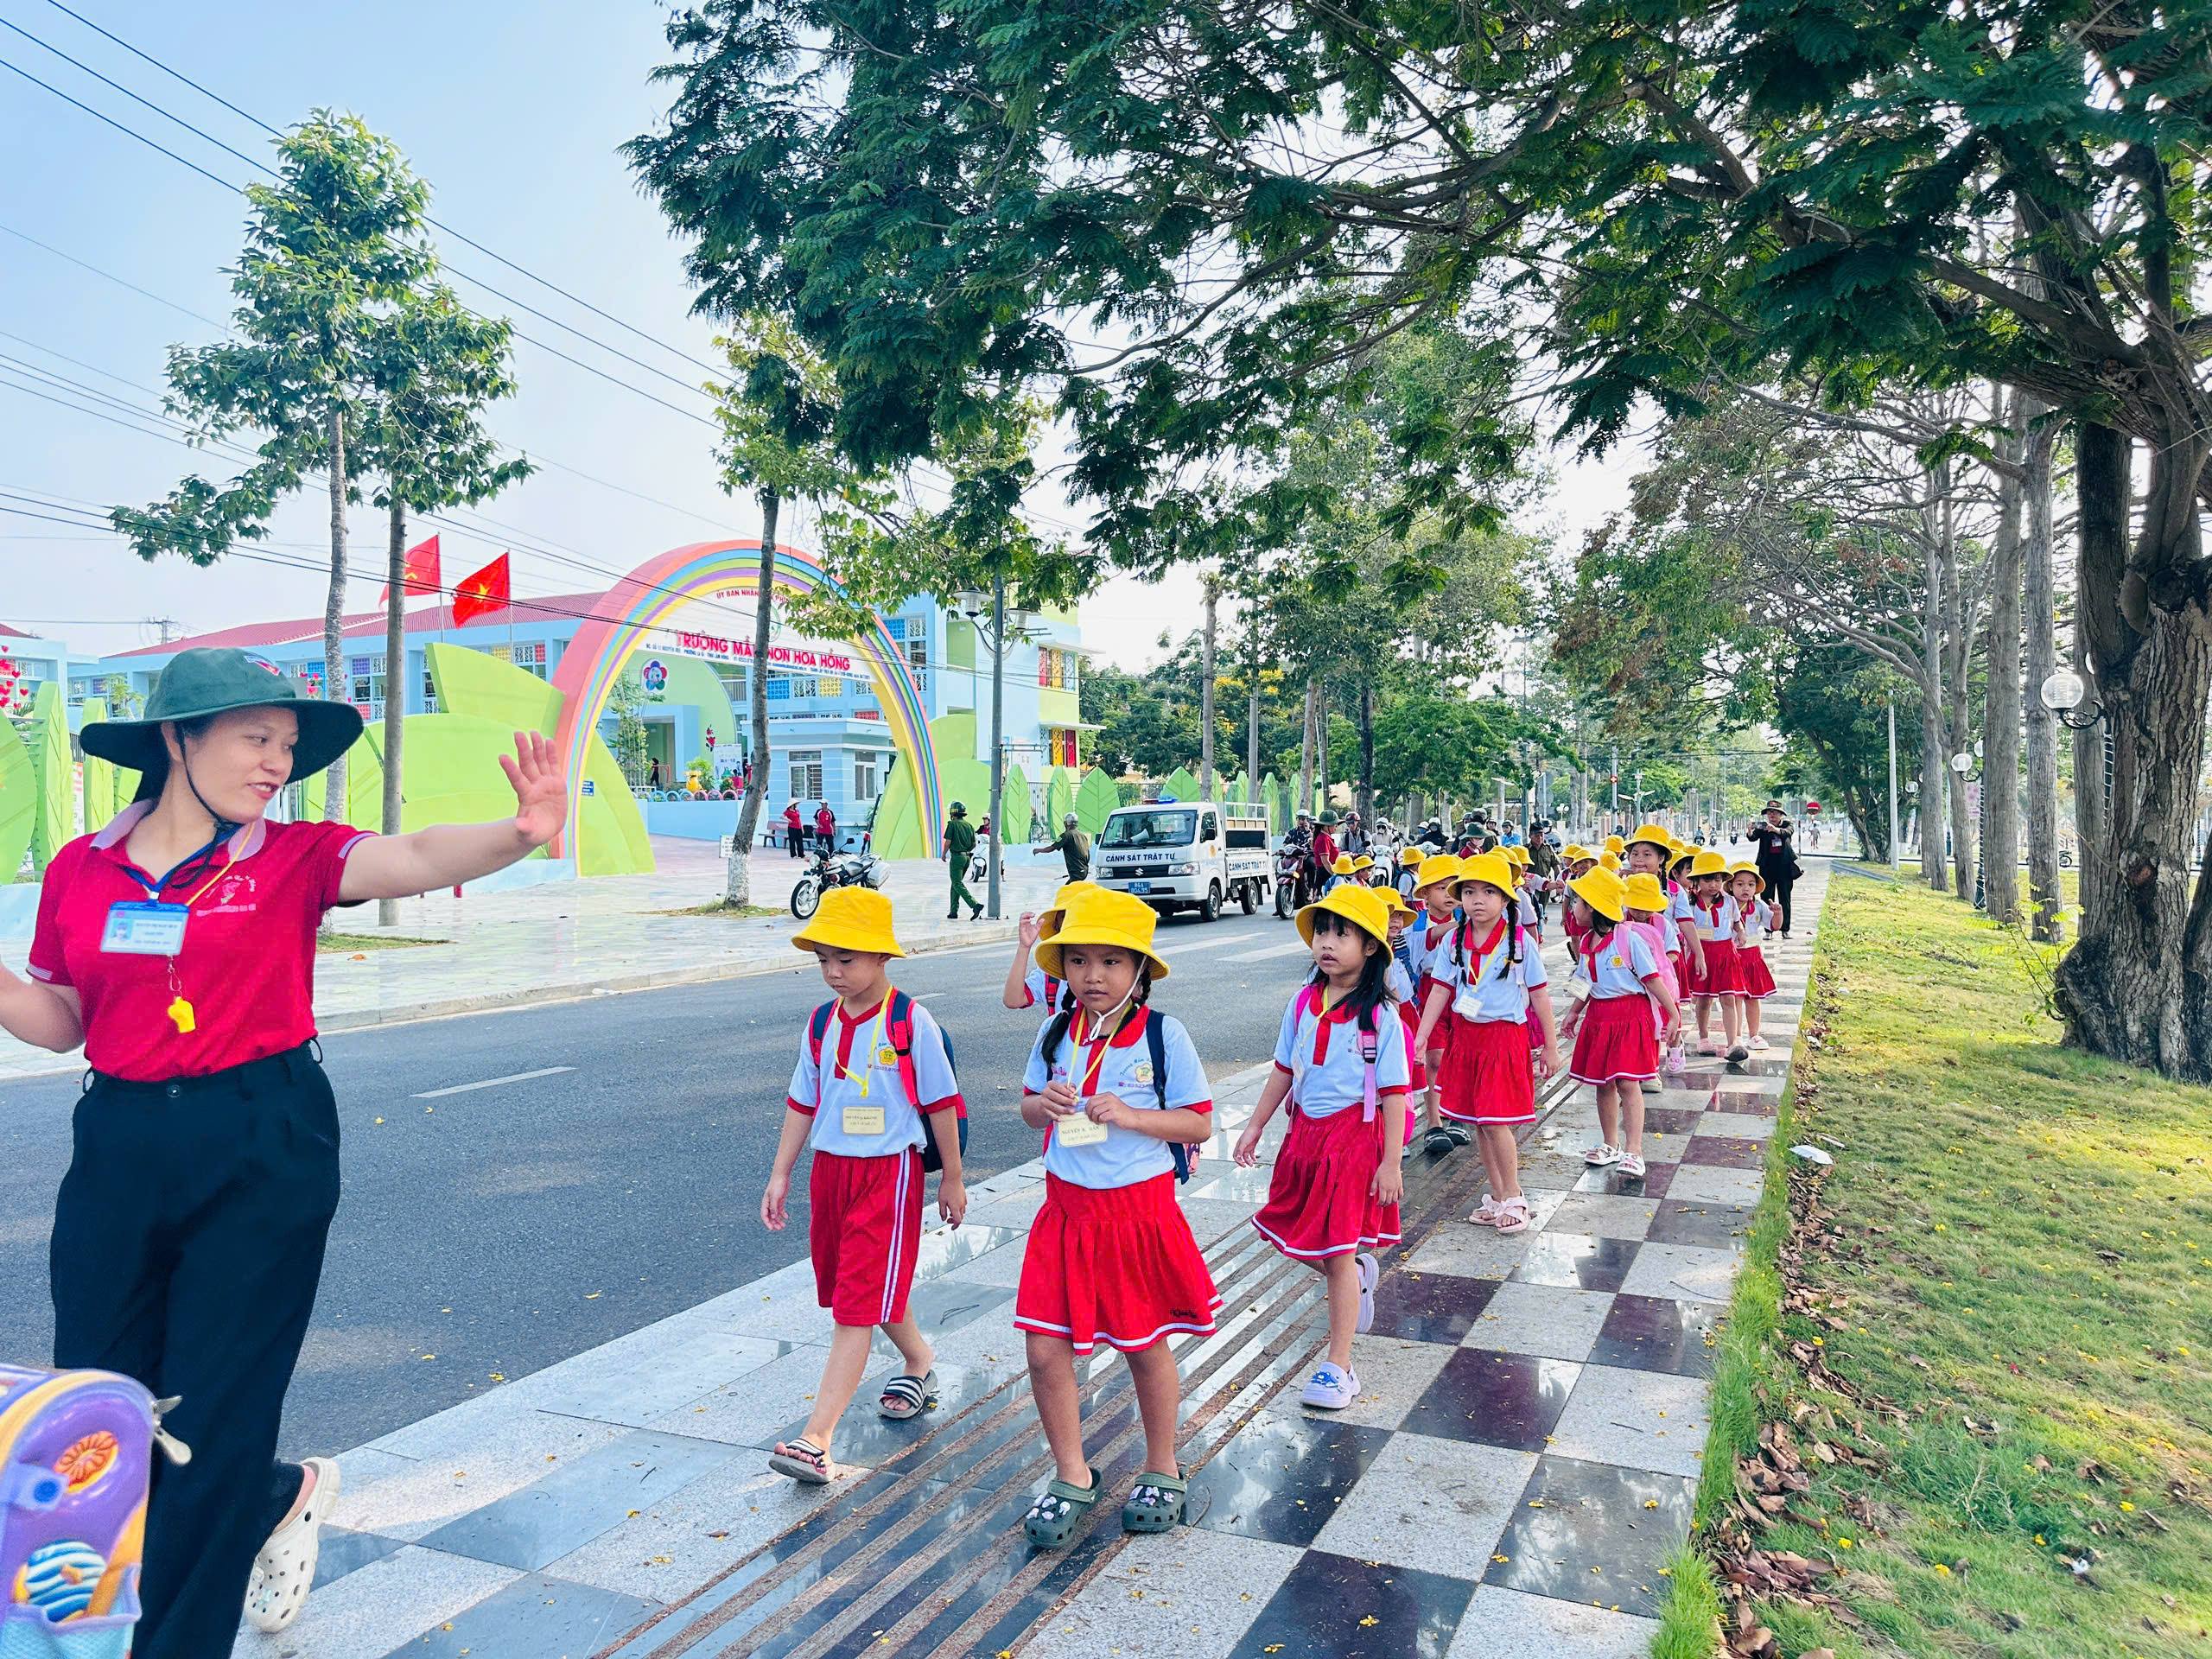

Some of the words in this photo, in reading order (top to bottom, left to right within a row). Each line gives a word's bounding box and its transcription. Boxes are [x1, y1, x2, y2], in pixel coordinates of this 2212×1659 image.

[727, 589, 740, 598] BAN
[733, 635, 755, 657] MẦ
[821, 648, 850, 671] HỒNG
[1106, 853, 1125, 862] CẢNH
[1127, 852, 1141, 861] SÁT
[1143, 852, 1163, 862] TRẬT
